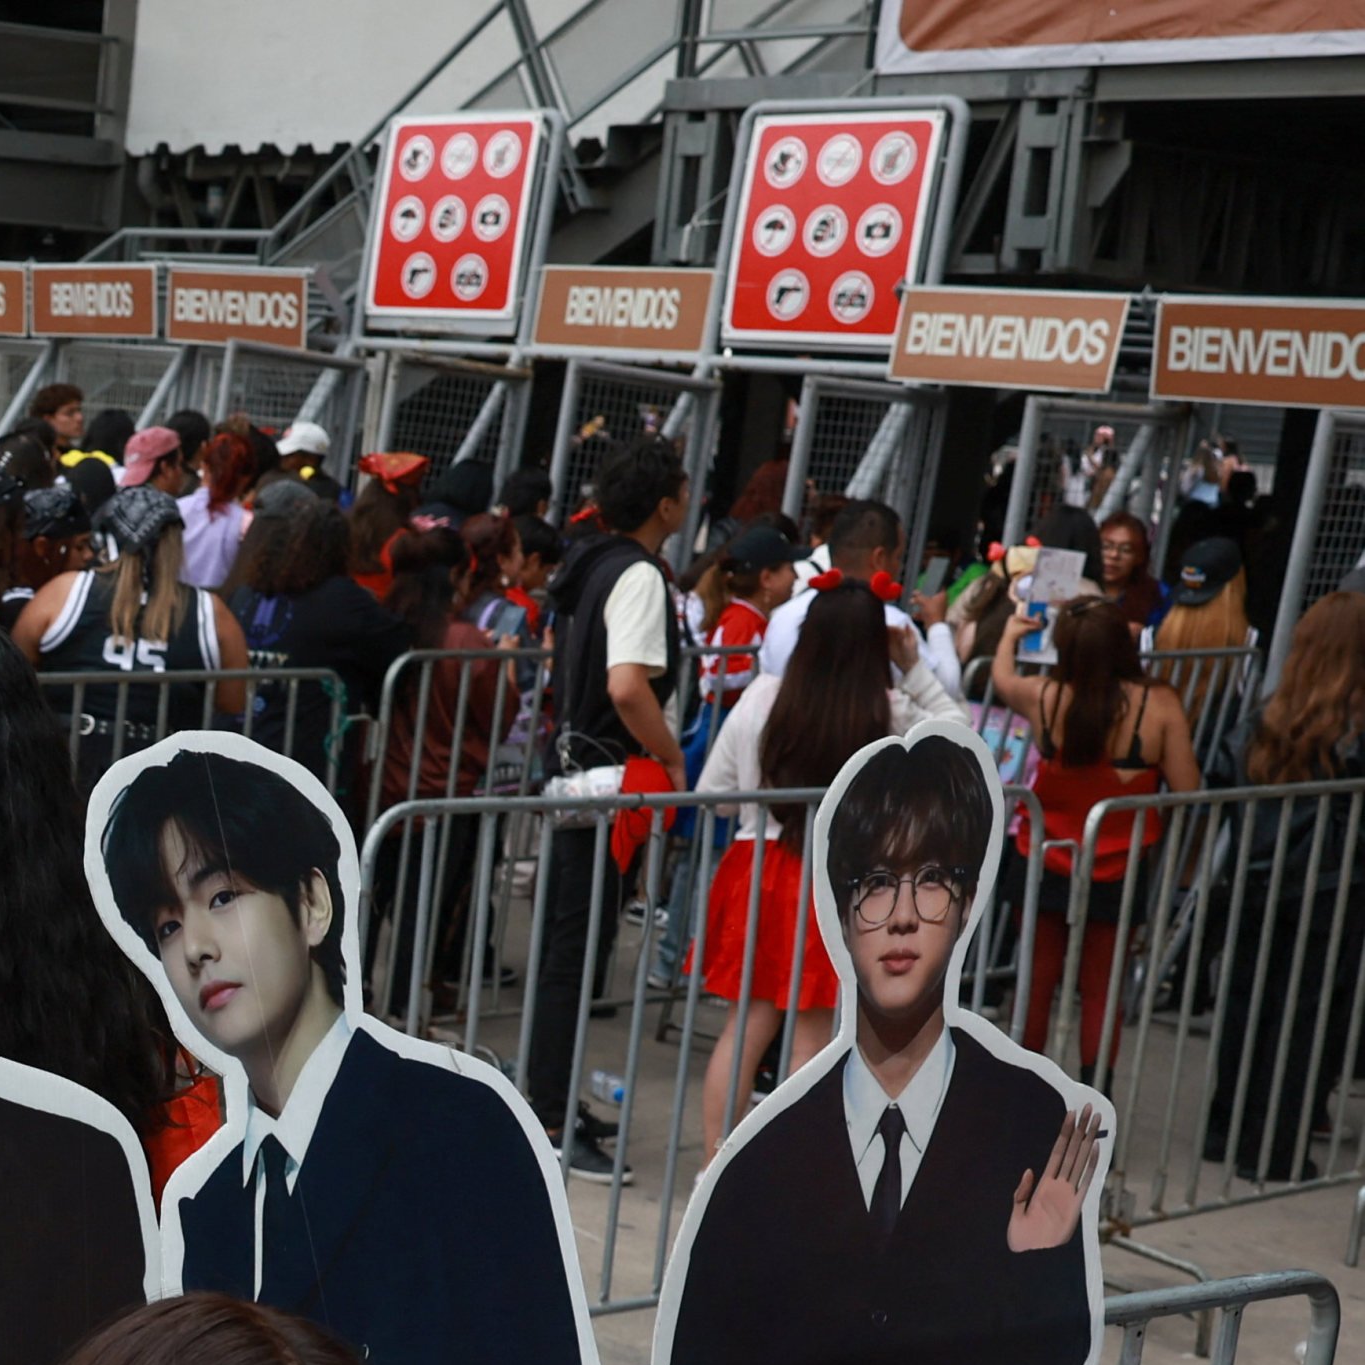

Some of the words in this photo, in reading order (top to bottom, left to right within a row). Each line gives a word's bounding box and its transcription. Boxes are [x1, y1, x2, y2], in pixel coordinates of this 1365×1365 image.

[50, 281, 133, 318] BIENVENIDOS
[174, 288, 299, 329] BIENVENIDOS
[564, 285, 681, 330] BIENVENIDOS
[905, 311, 1109, 366] BIENVENIDOS
